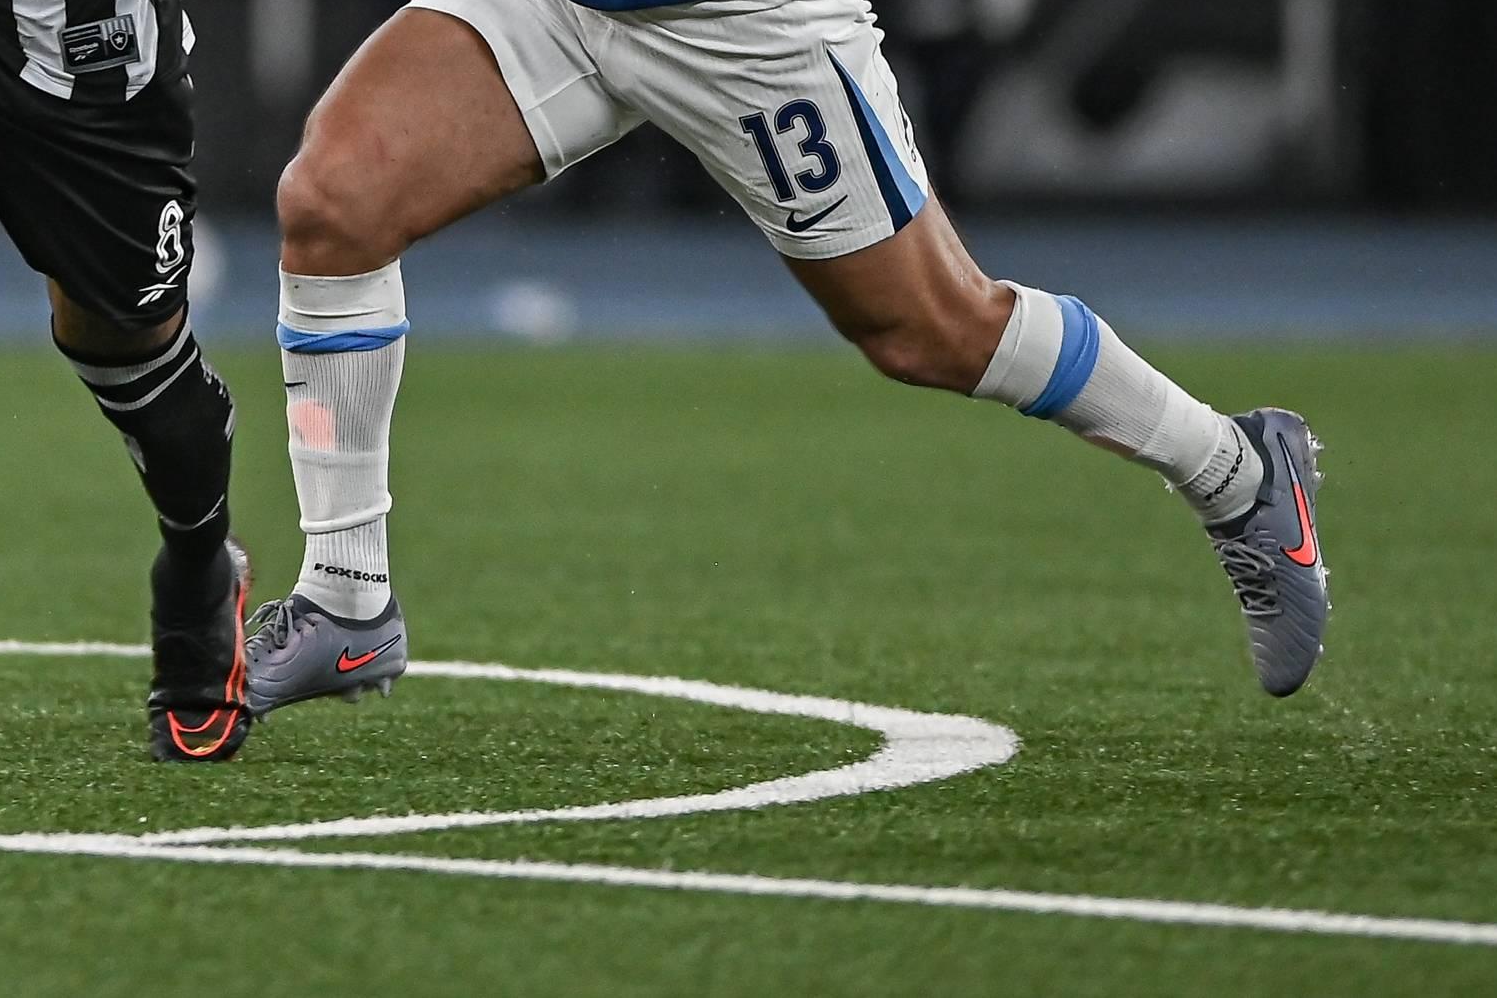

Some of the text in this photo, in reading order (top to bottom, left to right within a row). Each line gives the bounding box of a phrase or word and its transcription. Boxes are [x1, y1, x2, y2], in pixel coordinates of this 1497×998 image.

[739, 98, 842, 203] 13
[155, 199, 184, 275] 8
[313, 563, 388, 583] FOXSOCKS
